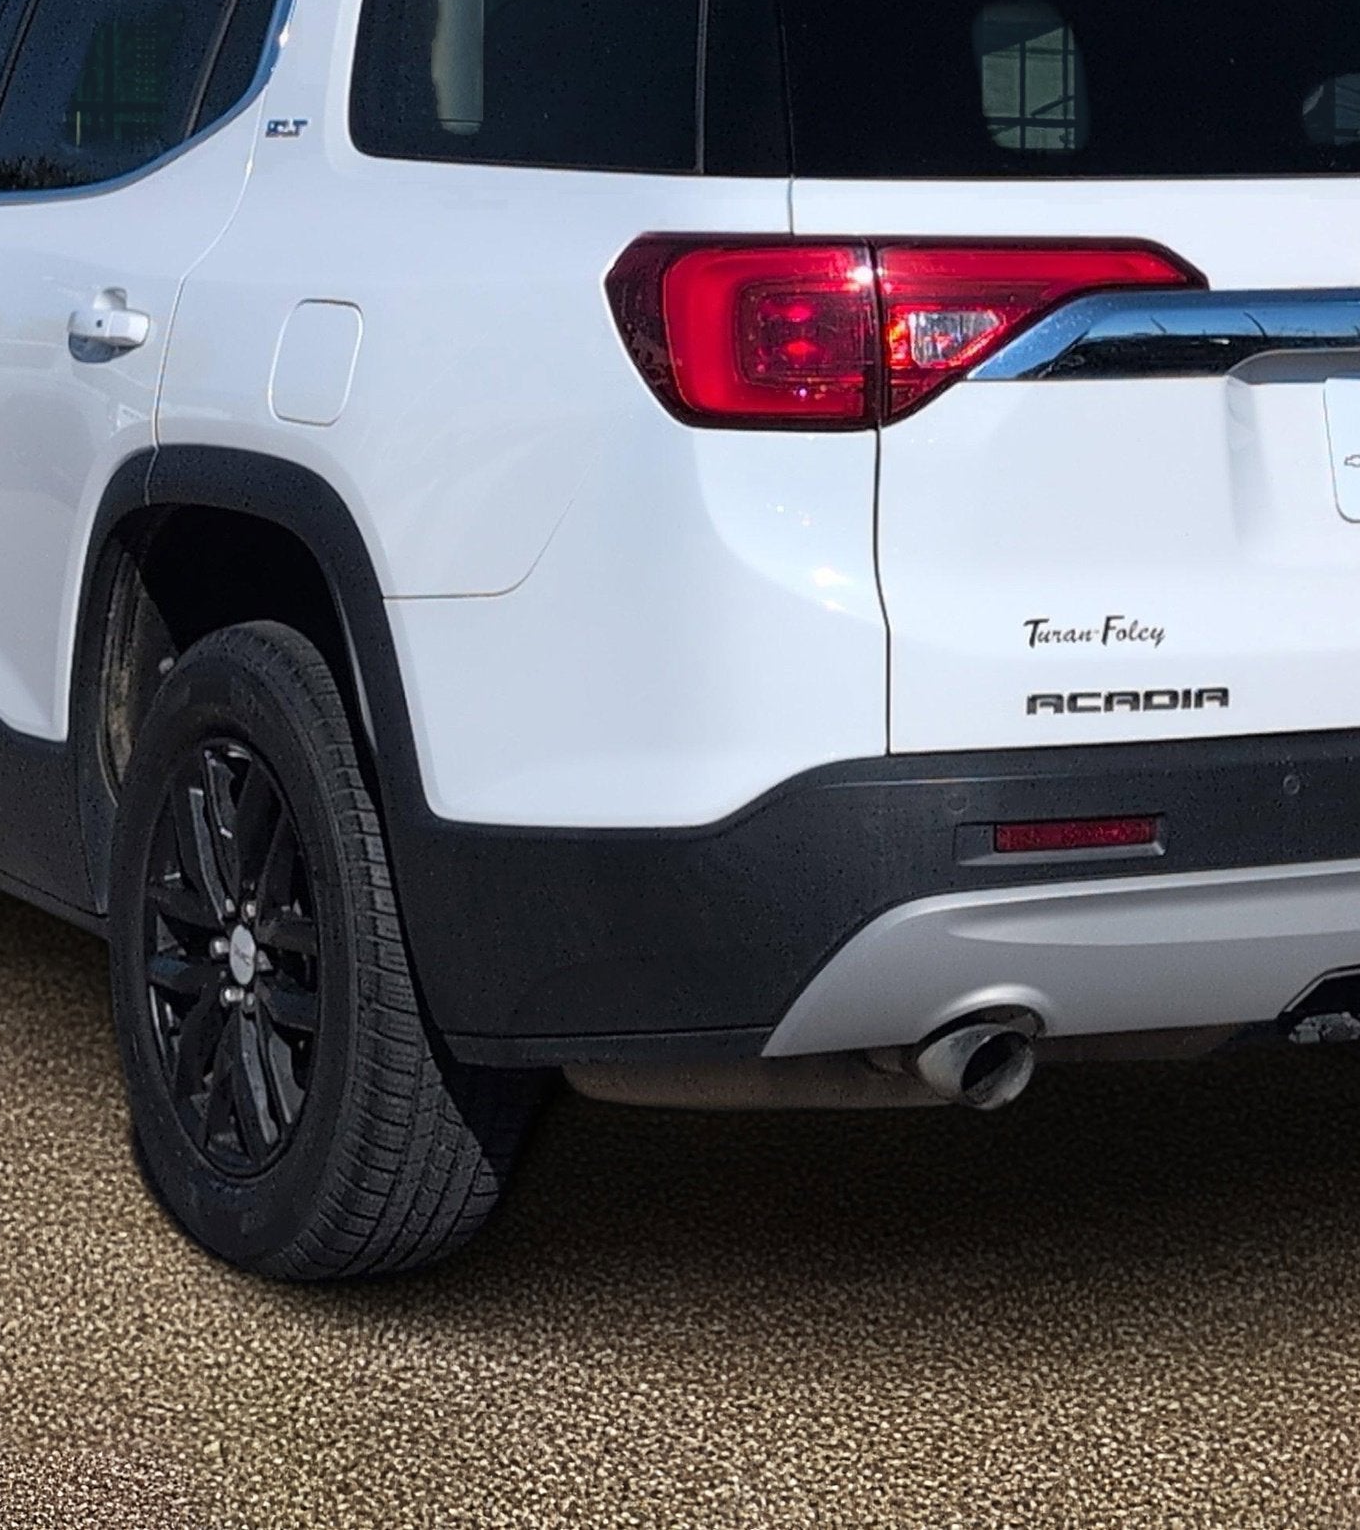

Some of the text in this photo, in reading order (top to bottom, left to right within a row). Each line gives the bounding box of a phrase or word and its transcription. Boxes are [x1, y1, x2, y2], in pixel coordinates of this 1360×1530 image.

[1023, 615, 1165, 648] Turan Foley
[1026, 687, 1229, 715] ACADIA
